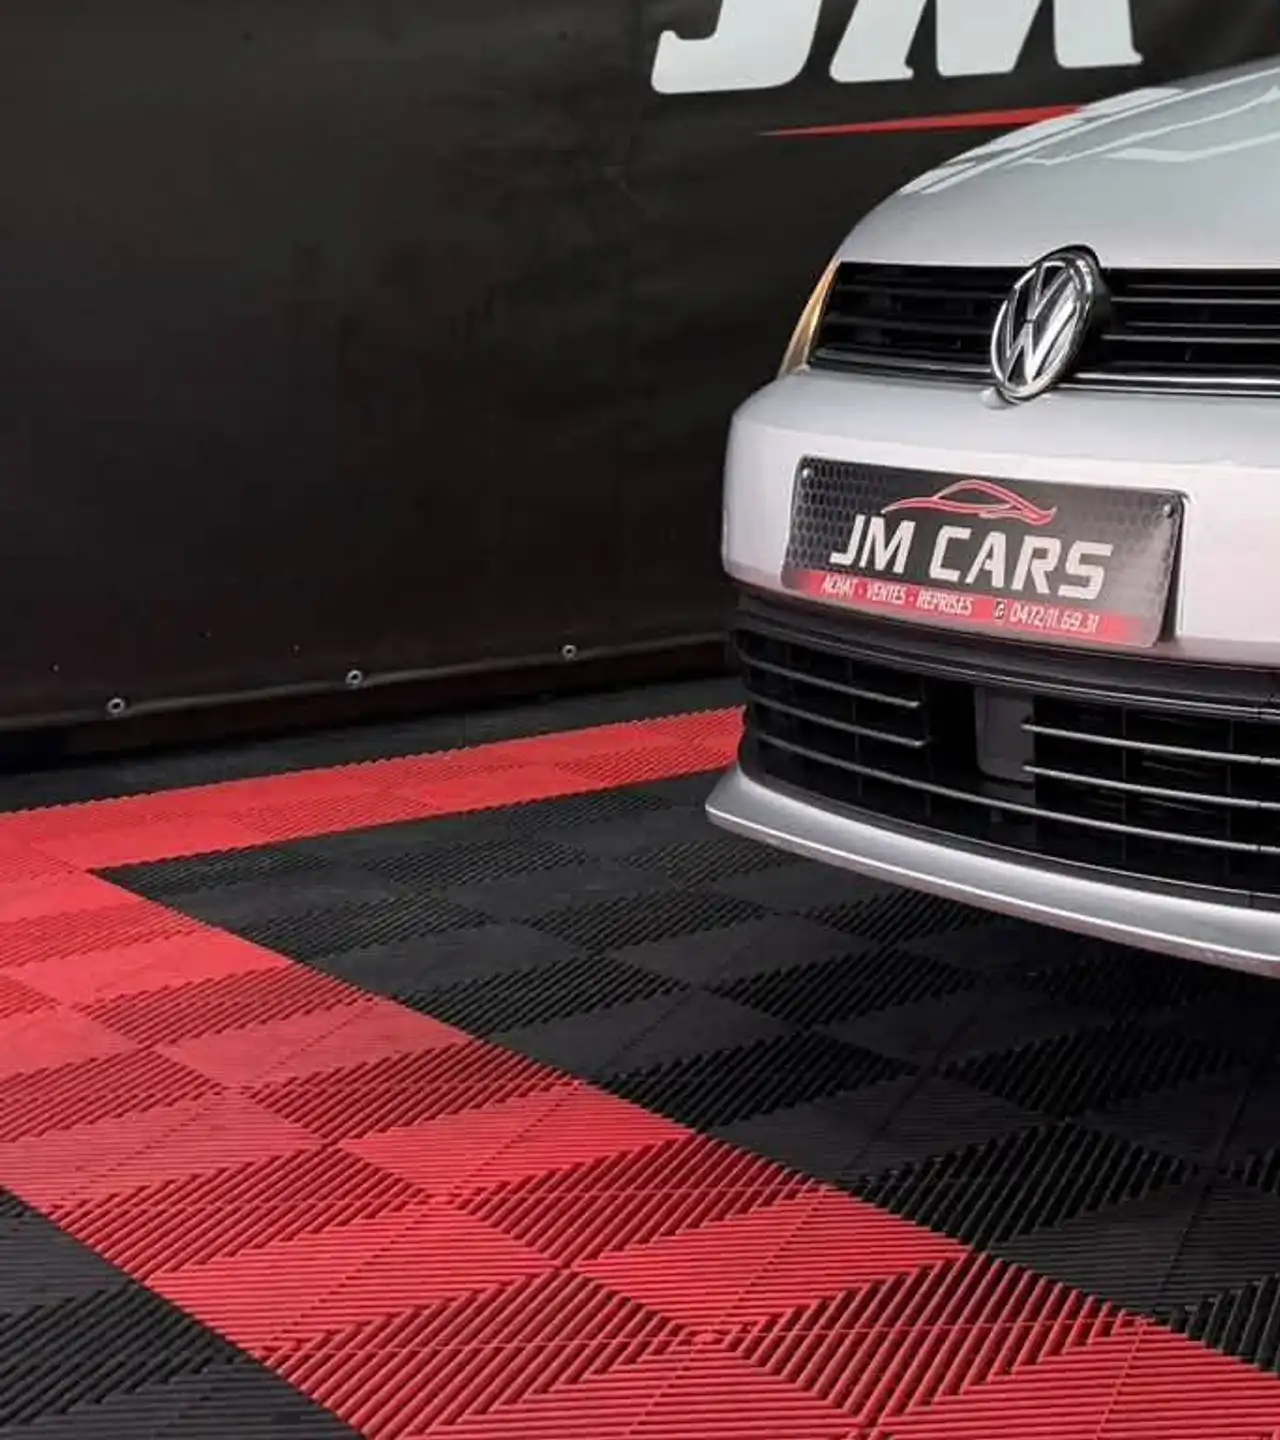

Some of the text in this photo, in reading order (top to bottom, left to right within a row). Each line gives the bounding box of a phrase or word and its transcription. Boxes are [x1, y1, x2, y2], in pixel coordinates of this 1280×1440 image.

[829, 514, 1113, 600] JM CARS
[820, 573, 859, 599] ACHAT
[866, 581, 906, 605] VENTES
[916, 588, 975, 616] REPRISES
